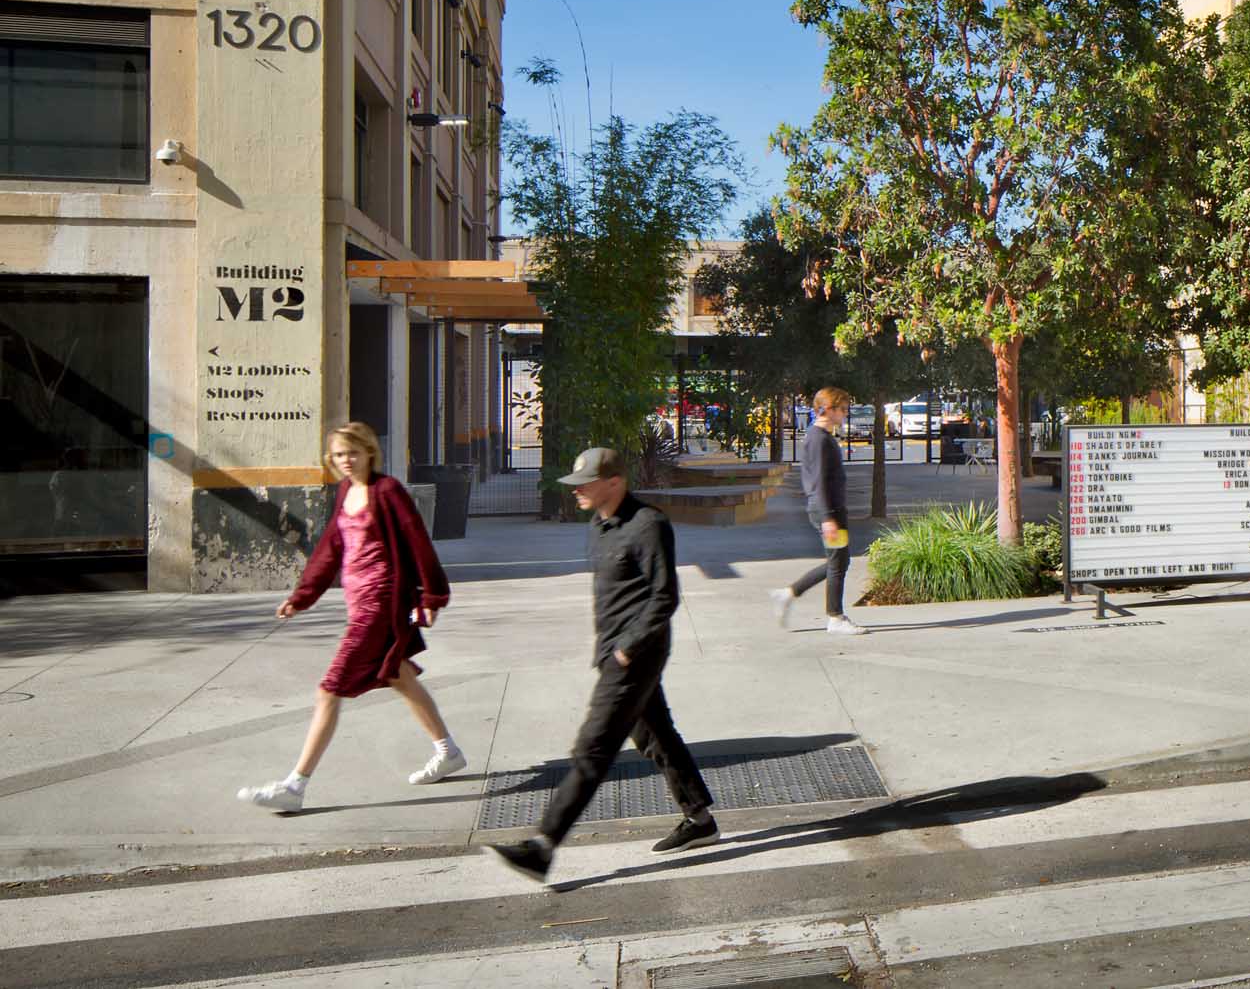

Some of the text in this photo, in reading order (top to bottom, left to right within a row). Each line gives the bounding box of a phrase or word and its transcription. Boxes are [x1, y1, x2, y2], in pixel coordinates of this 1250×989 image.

[207, 9, 322, 53] 1320
[216, 265, 304, 283] Building
[215, 286, 304, 322] M2
[208, 364, 311, 376] M2 Lobbies
[206, 388, 264, 401] Shops
[207, 410, 311, 421] Restrooms
[1125, 441, 1136, 449] OF
[1088, 452, 1117, 460] BANKS
[1121, 452, 1158, 460] JOURNAL
[1203, 450, 1236, 458] MISSION
[1089, 463, 1110, 471] YOLK
[1217, 460, 1245, 468] BRIDGE
[1088, 473, 1133, 481] TOKYOBIKE
[1225, 470, 1248, 478] ERICA
[1088, 494, 1122, 503] HAYATO
[1088, 505, 1133, 514] OMAMIMINI
[1089, 515, 1119, 524] GIMBAL
[1090, 526, 1106, 535] ARC
[1120, 525, 1141, 533] GOOD
[1146, 524, 1172, 532] FILMS
[1071, 562, 1233, 578] SHOPS OPEN TO THE LEFT AND RIGHT
